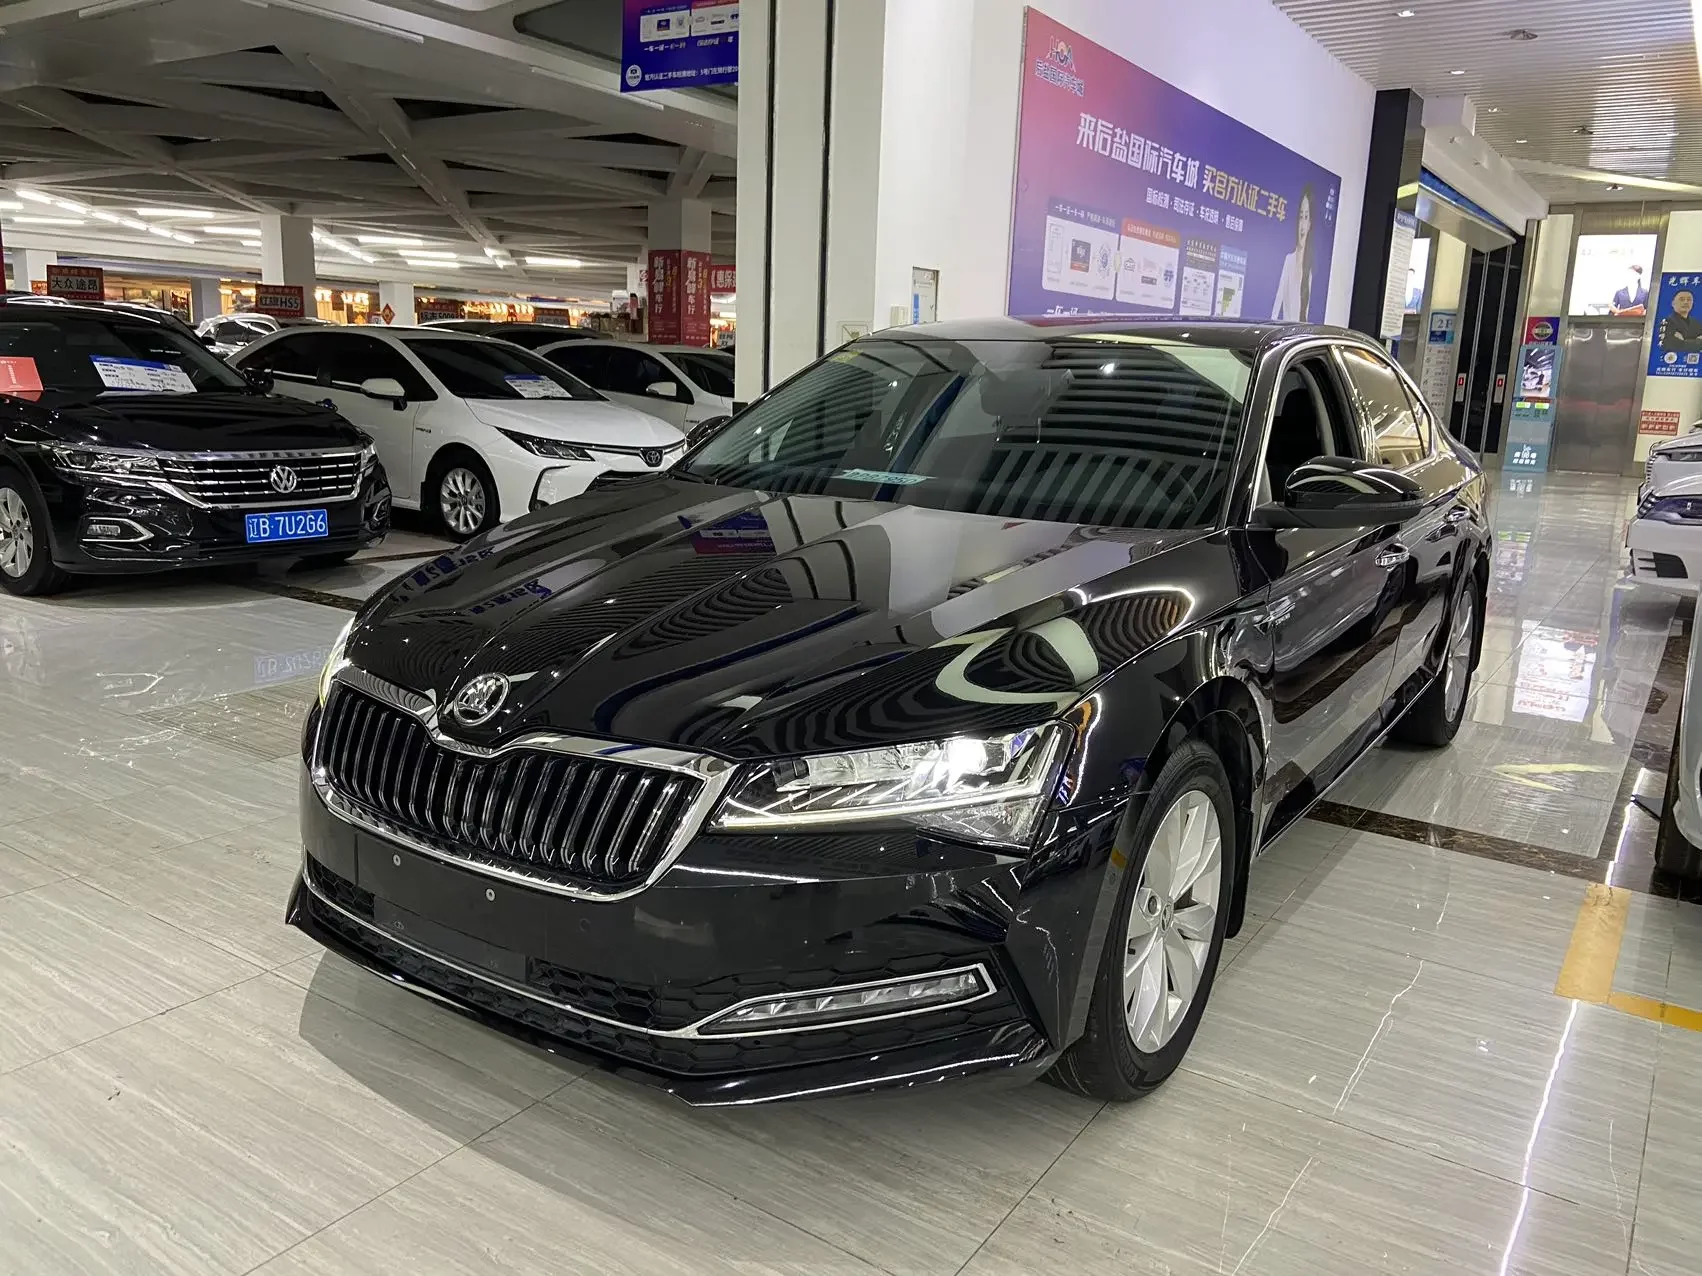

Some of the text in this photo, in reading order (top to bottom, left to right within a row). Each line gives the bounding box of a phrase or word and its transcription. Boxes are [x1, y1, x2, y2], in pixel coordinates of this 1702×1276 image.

[1076, 112, 1200, 190] 来后盐国际汽车城
[1202, 164, 1288, 222] 买官方认证二手车
[52, 277, 98, 291] 大众途昂
[249, 514, 326, 538] 辽B·7U2G6
